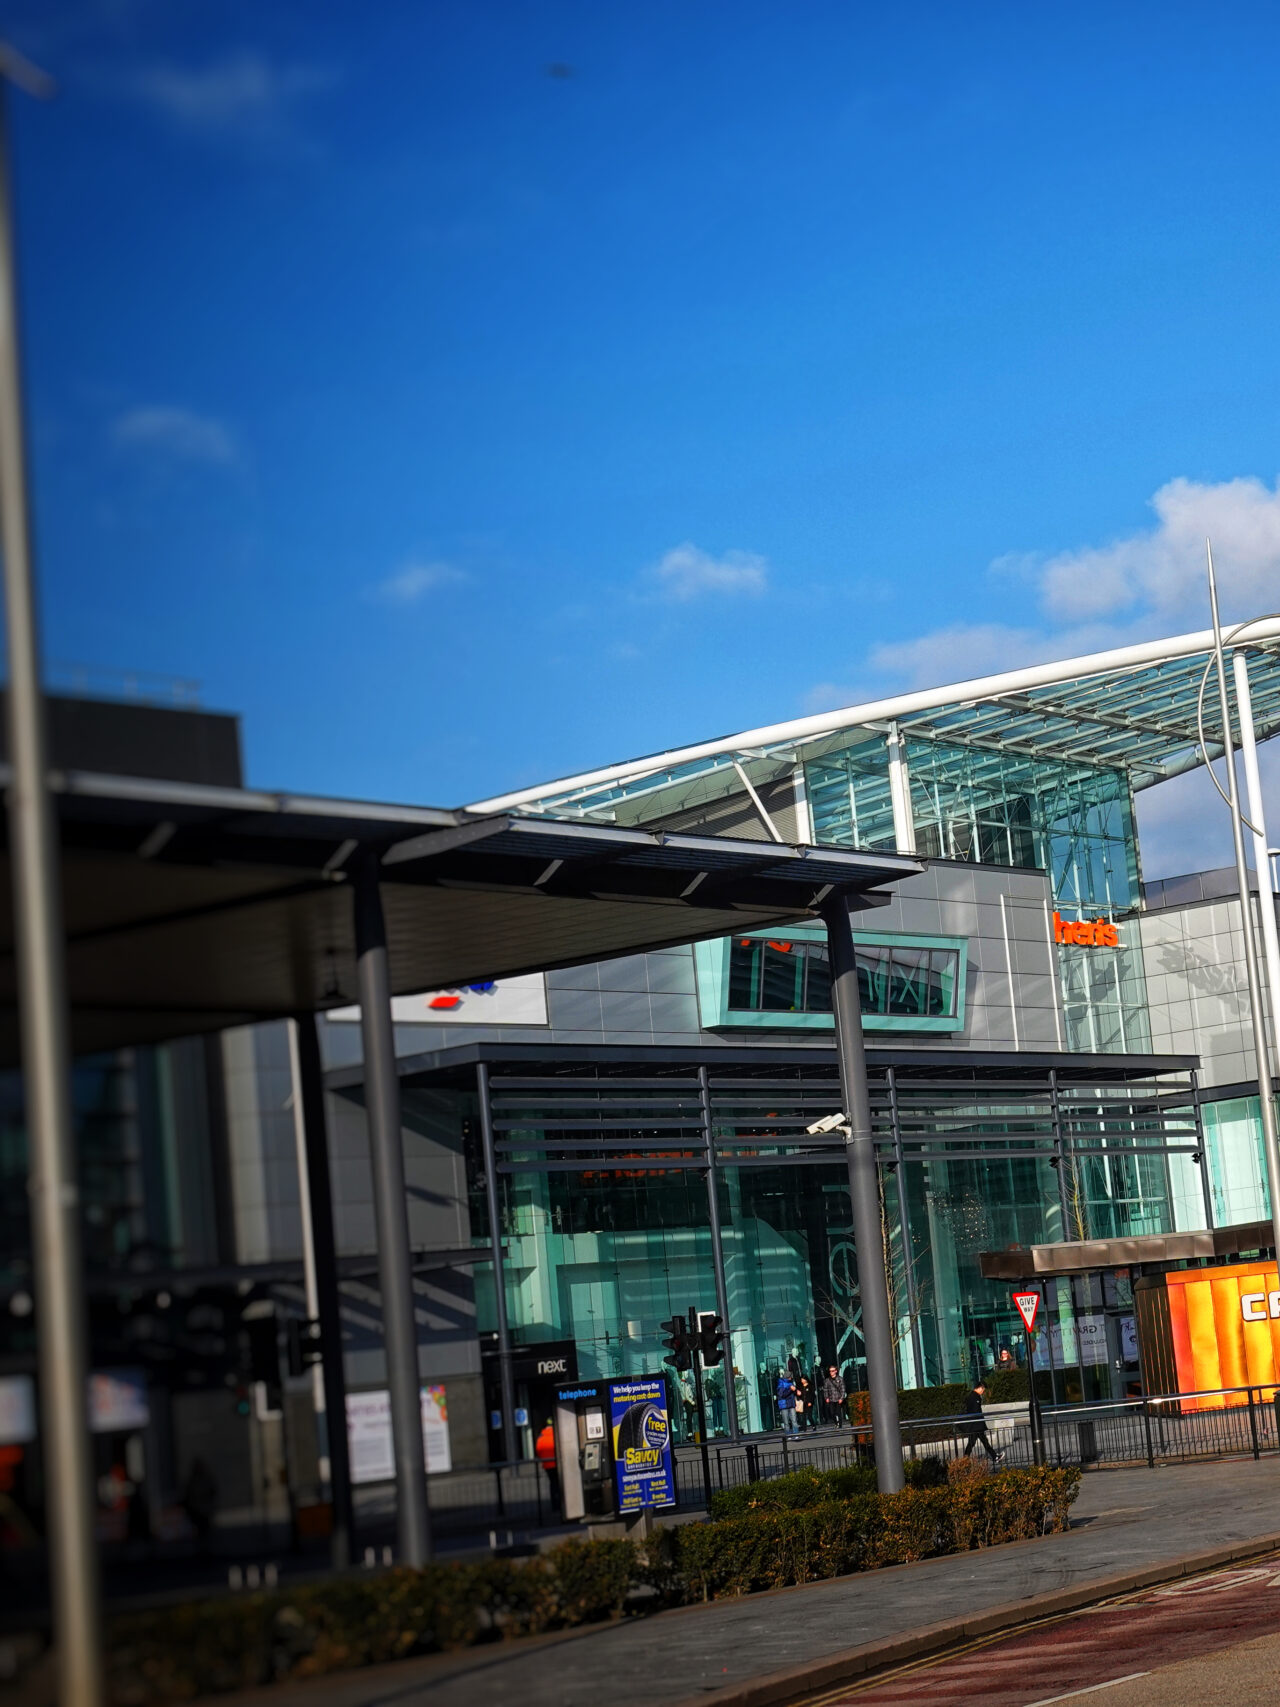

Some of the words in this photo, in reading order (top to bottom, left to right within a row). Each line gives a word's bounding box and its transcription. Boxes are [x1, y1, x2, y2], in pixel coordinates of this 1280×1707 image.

[1019, 1296, 1035, 1306] GIVE
[538, 1359, 567, 1374] next
[558, 1388, 597, 1400] telephone
[648, 1417, 666, 1432] free
[626, 1447, 660, 1466] Savoy
